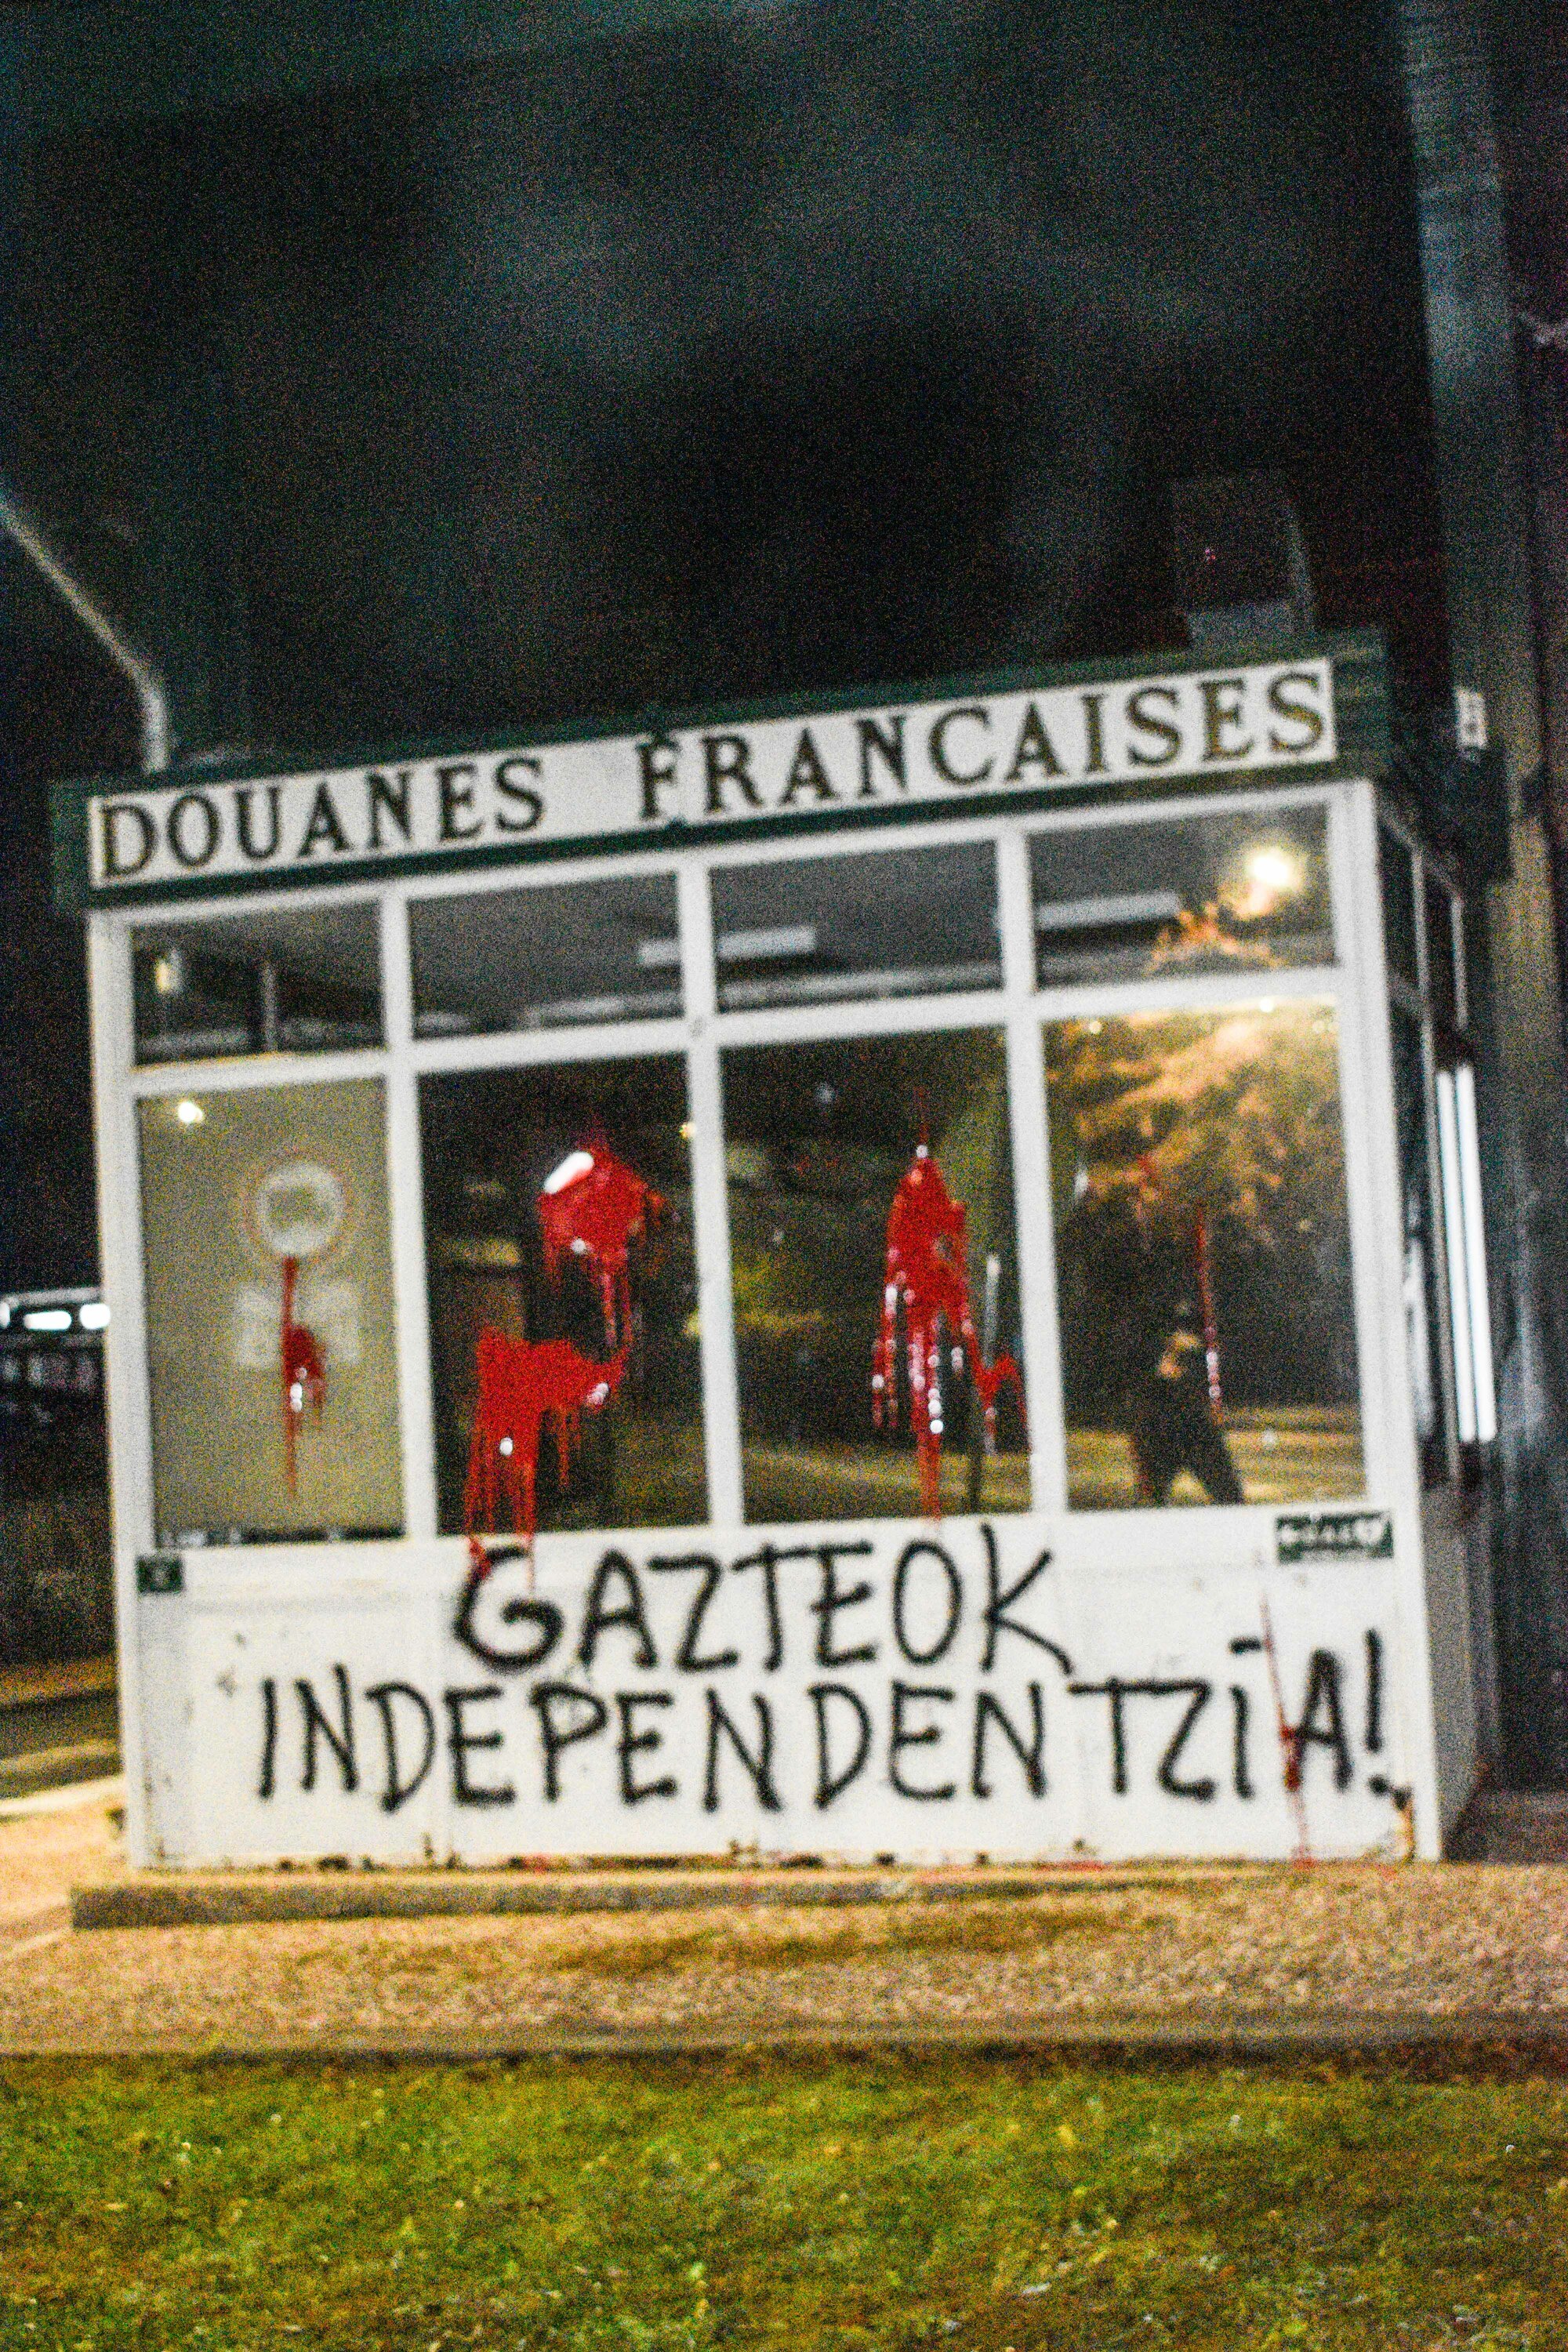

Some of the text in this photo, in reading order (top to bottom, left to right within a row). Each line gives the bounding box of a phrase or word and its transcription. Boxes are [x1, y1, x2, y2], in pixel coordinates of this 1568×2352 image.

[99, 672, 1327, 878] DOUANES FRANCAISES
[454, 1523, 1074, 1673] GAZTEOK
